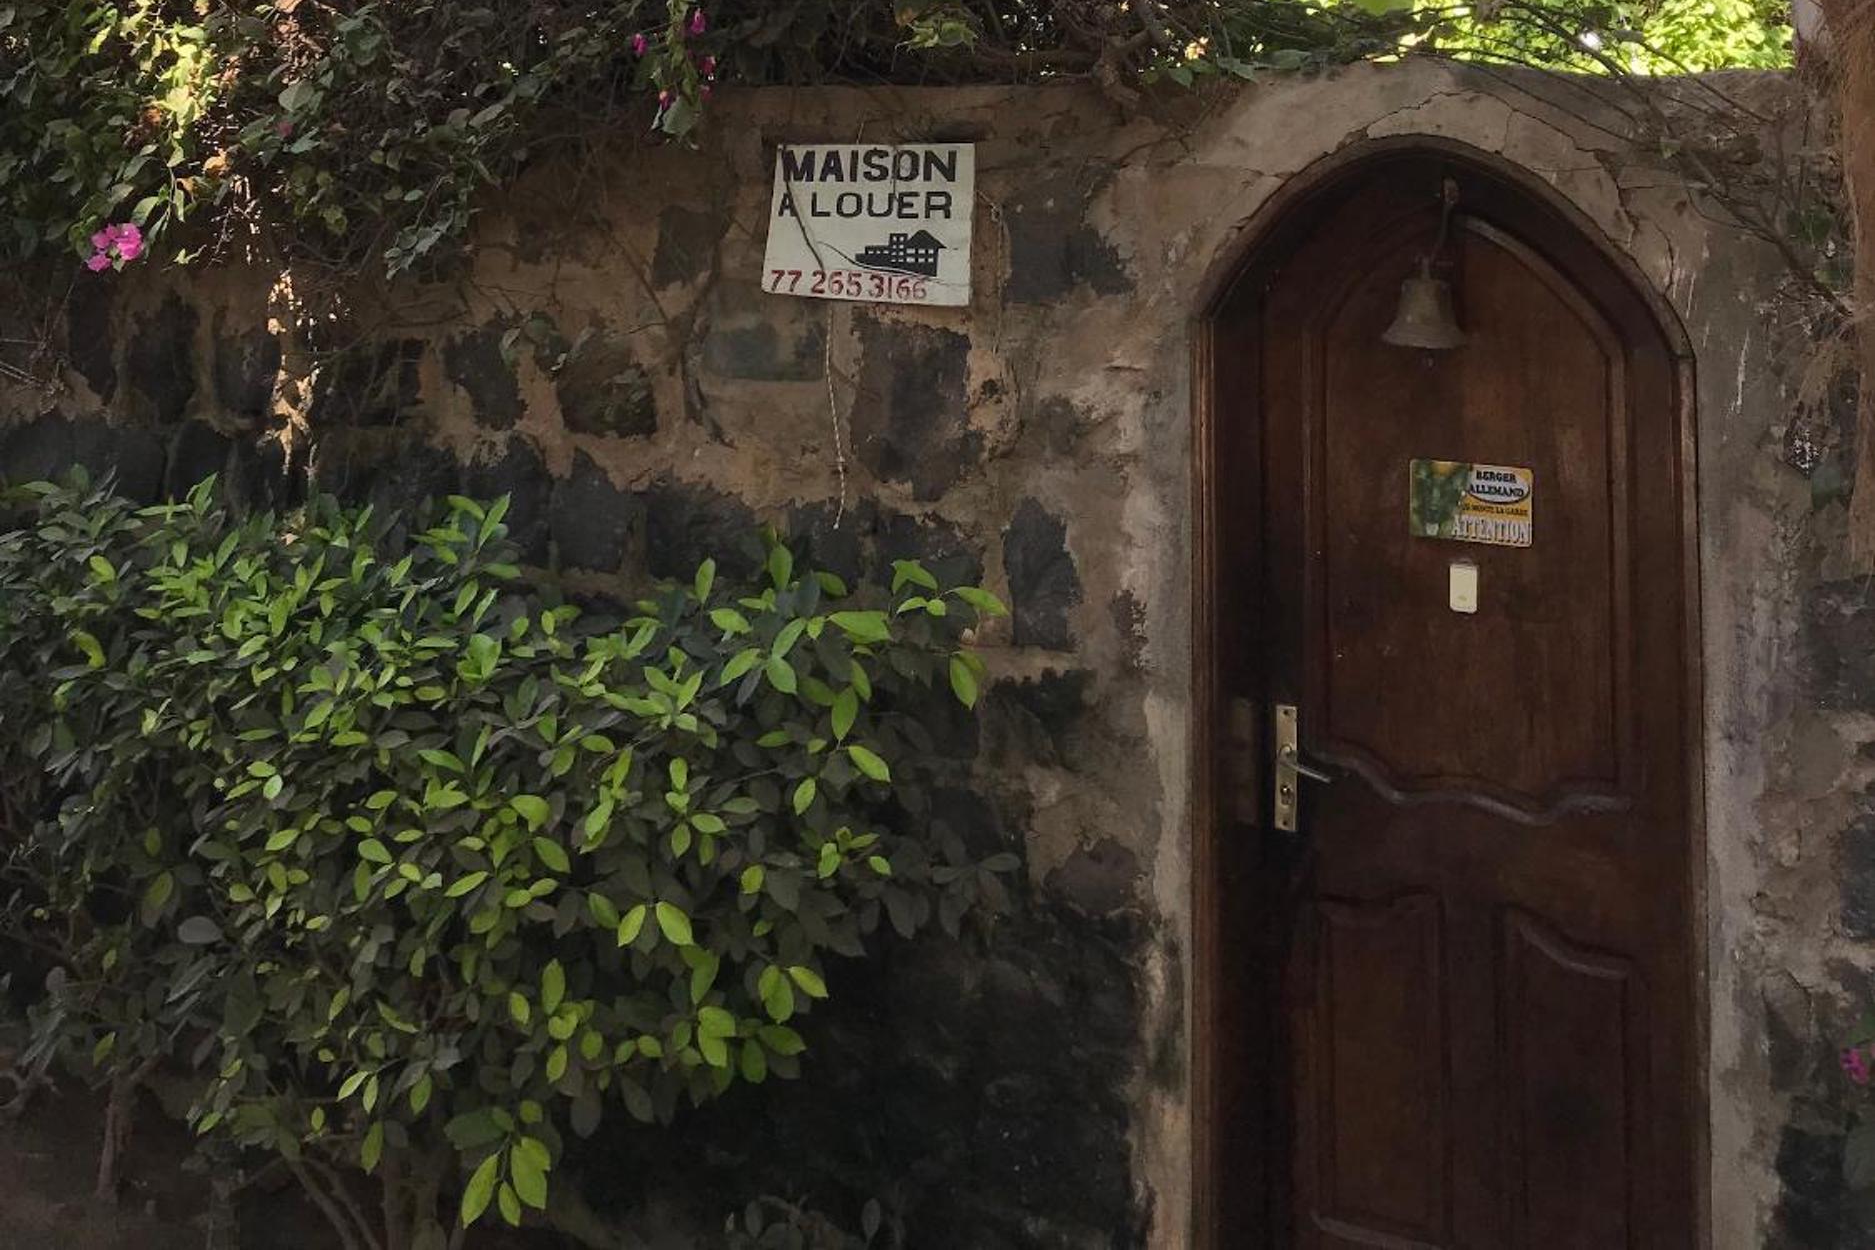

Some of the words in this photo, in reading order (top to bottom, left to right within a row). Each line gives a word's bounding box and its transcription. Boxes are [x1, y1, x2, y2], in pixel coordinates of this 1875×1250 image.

[781, 149, 957, 182] MAISON
[778, 193, 798, 217] A
[811, 191, 952, 219] LOUER
[771, 269, 803, 293] 77
[811, 270, 862, 298] 265
[868, 274, 927, 300] 3166
[1469, 484, 1525, 498] ALLEMAND
[1476, 470, 1518, 484] BERGER
[1451, 514, 1530, 545] ATTENTION
